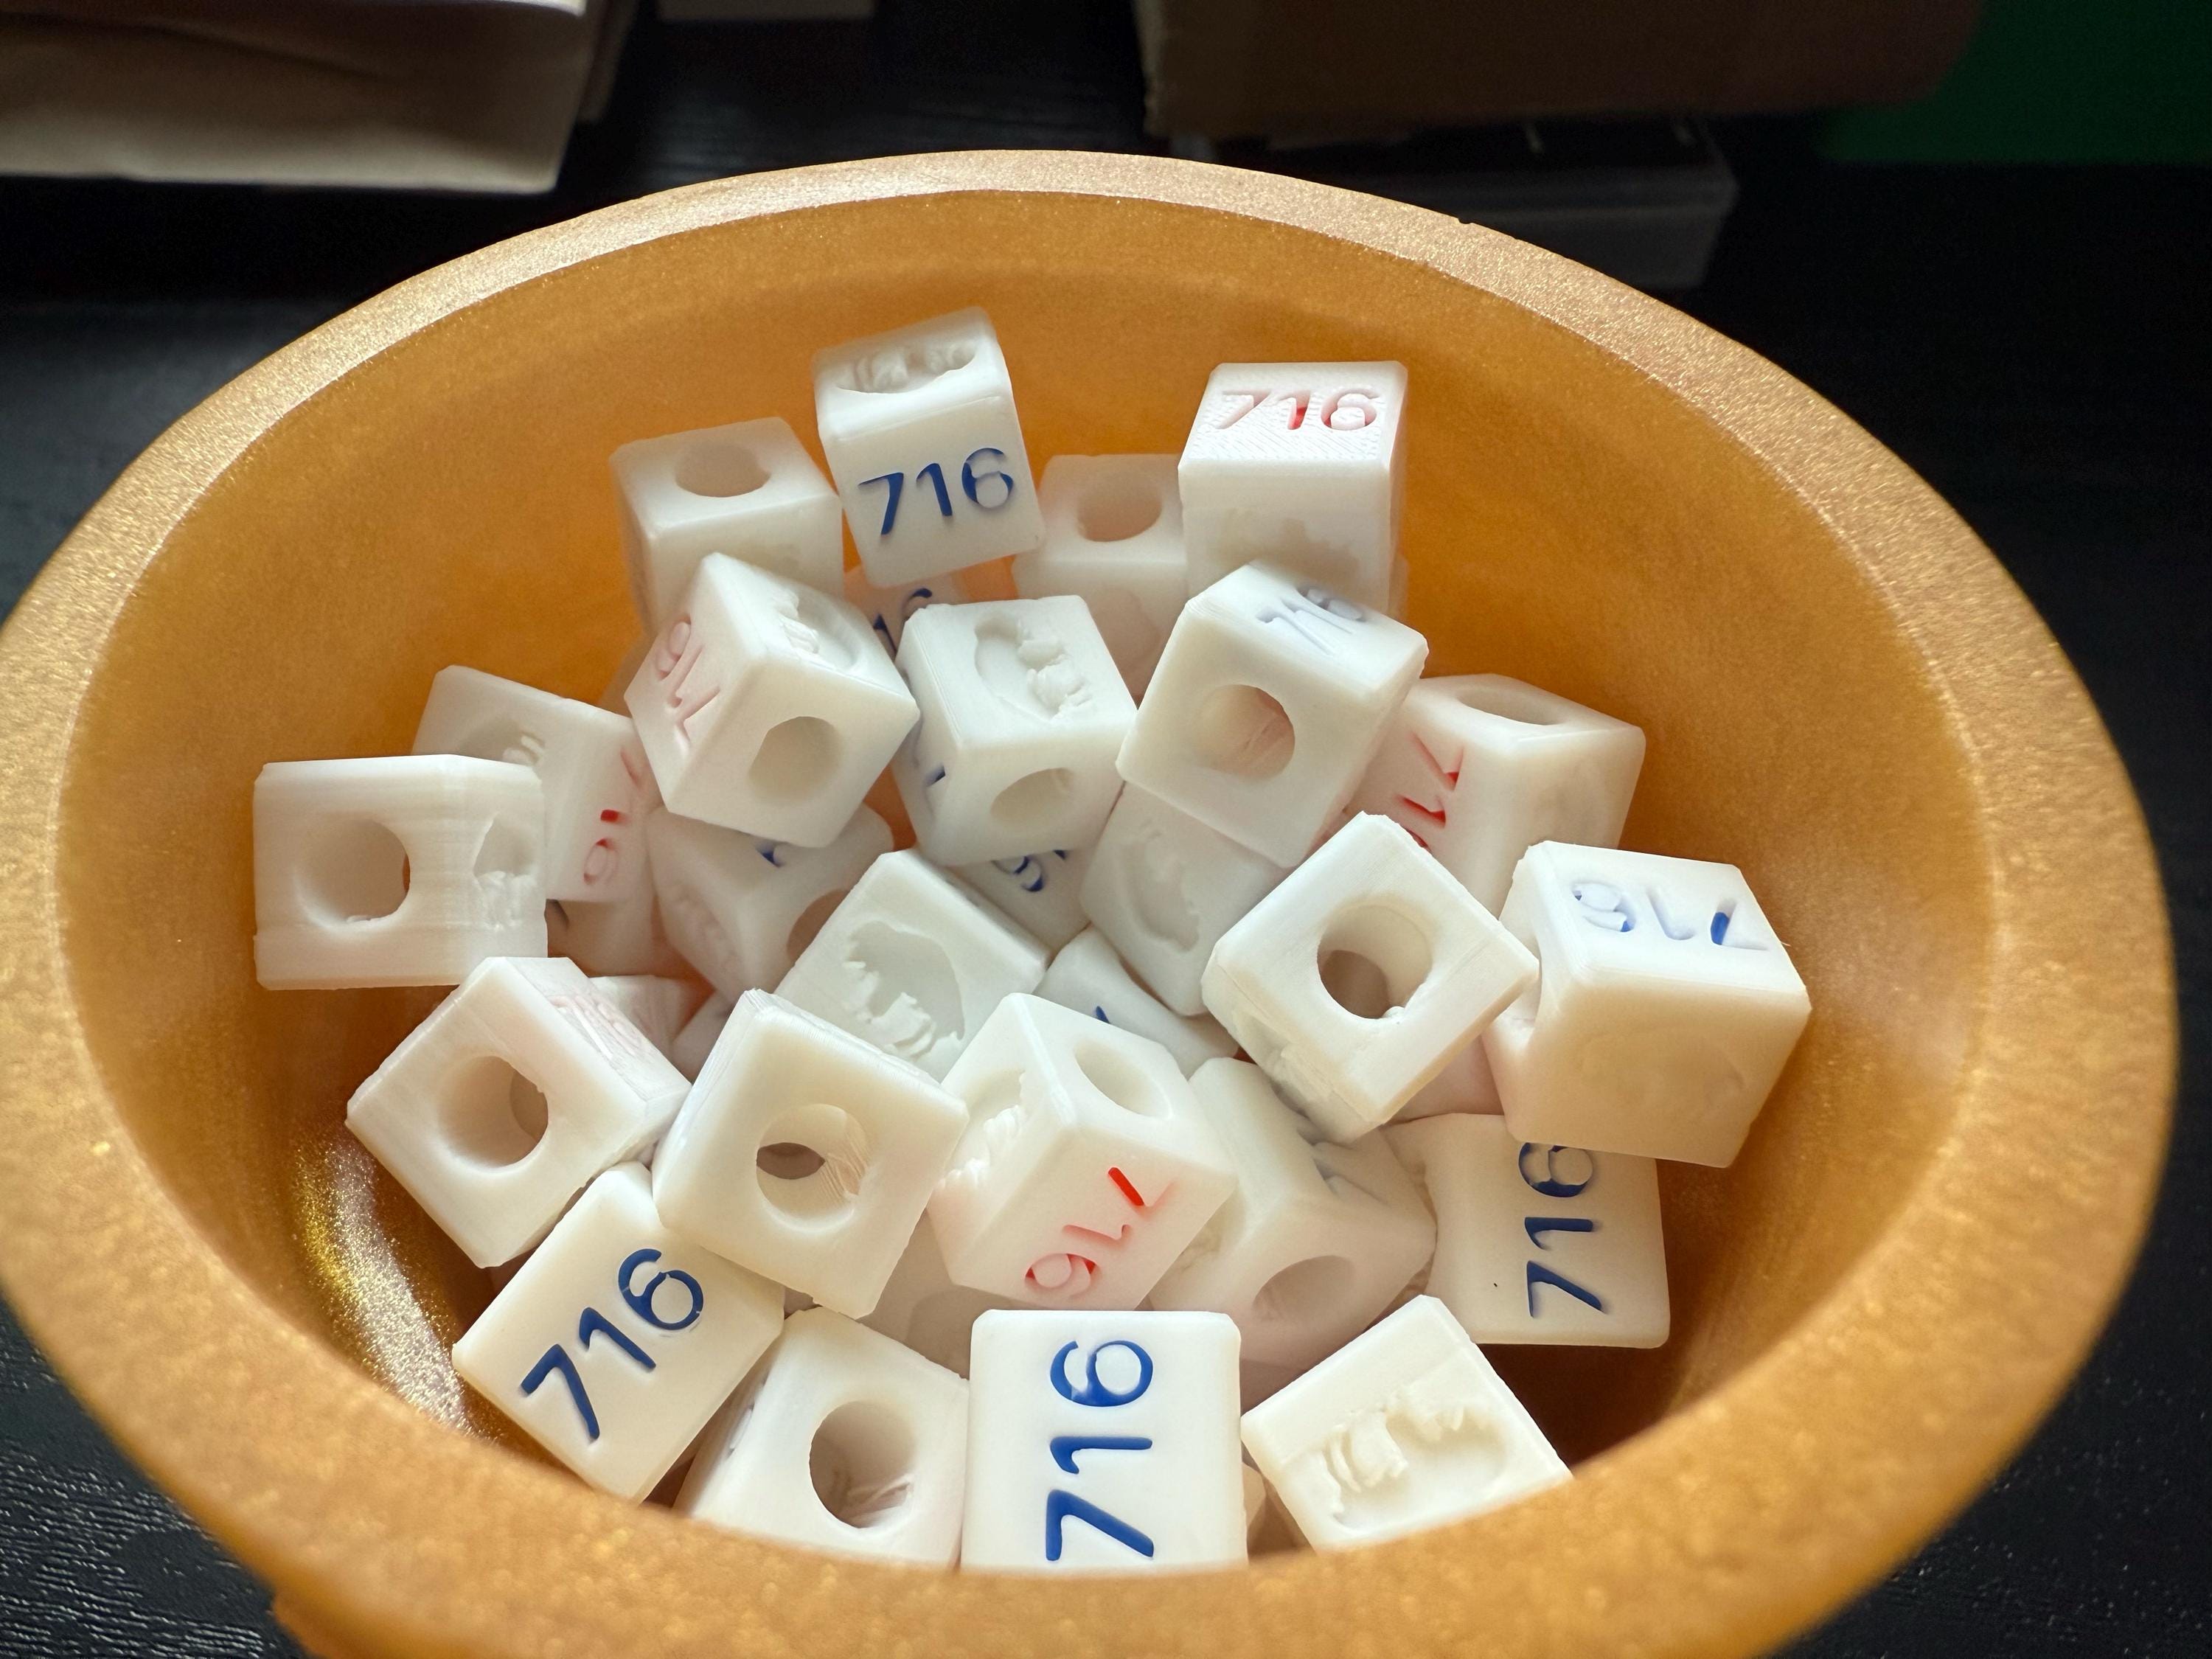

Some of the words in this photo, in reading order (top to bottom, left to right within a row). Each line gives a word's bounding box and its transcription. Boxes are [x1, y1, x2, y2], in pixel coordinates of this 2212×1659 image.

[1215, 387, 1380, 431] 716
[858, 447, 1015, 537] 716
[655, 612, 721, 746] 716
[1392, 730, 1464, 853] 71
[1569, 880, 1768, 951] 716
[1023, 1166, 1177, 1299] 716
[1517, 1141, 1609, 1319] 716
[519, 1248, 704, 1443] 716
[1045, 1339, 1155, 1562] 716
